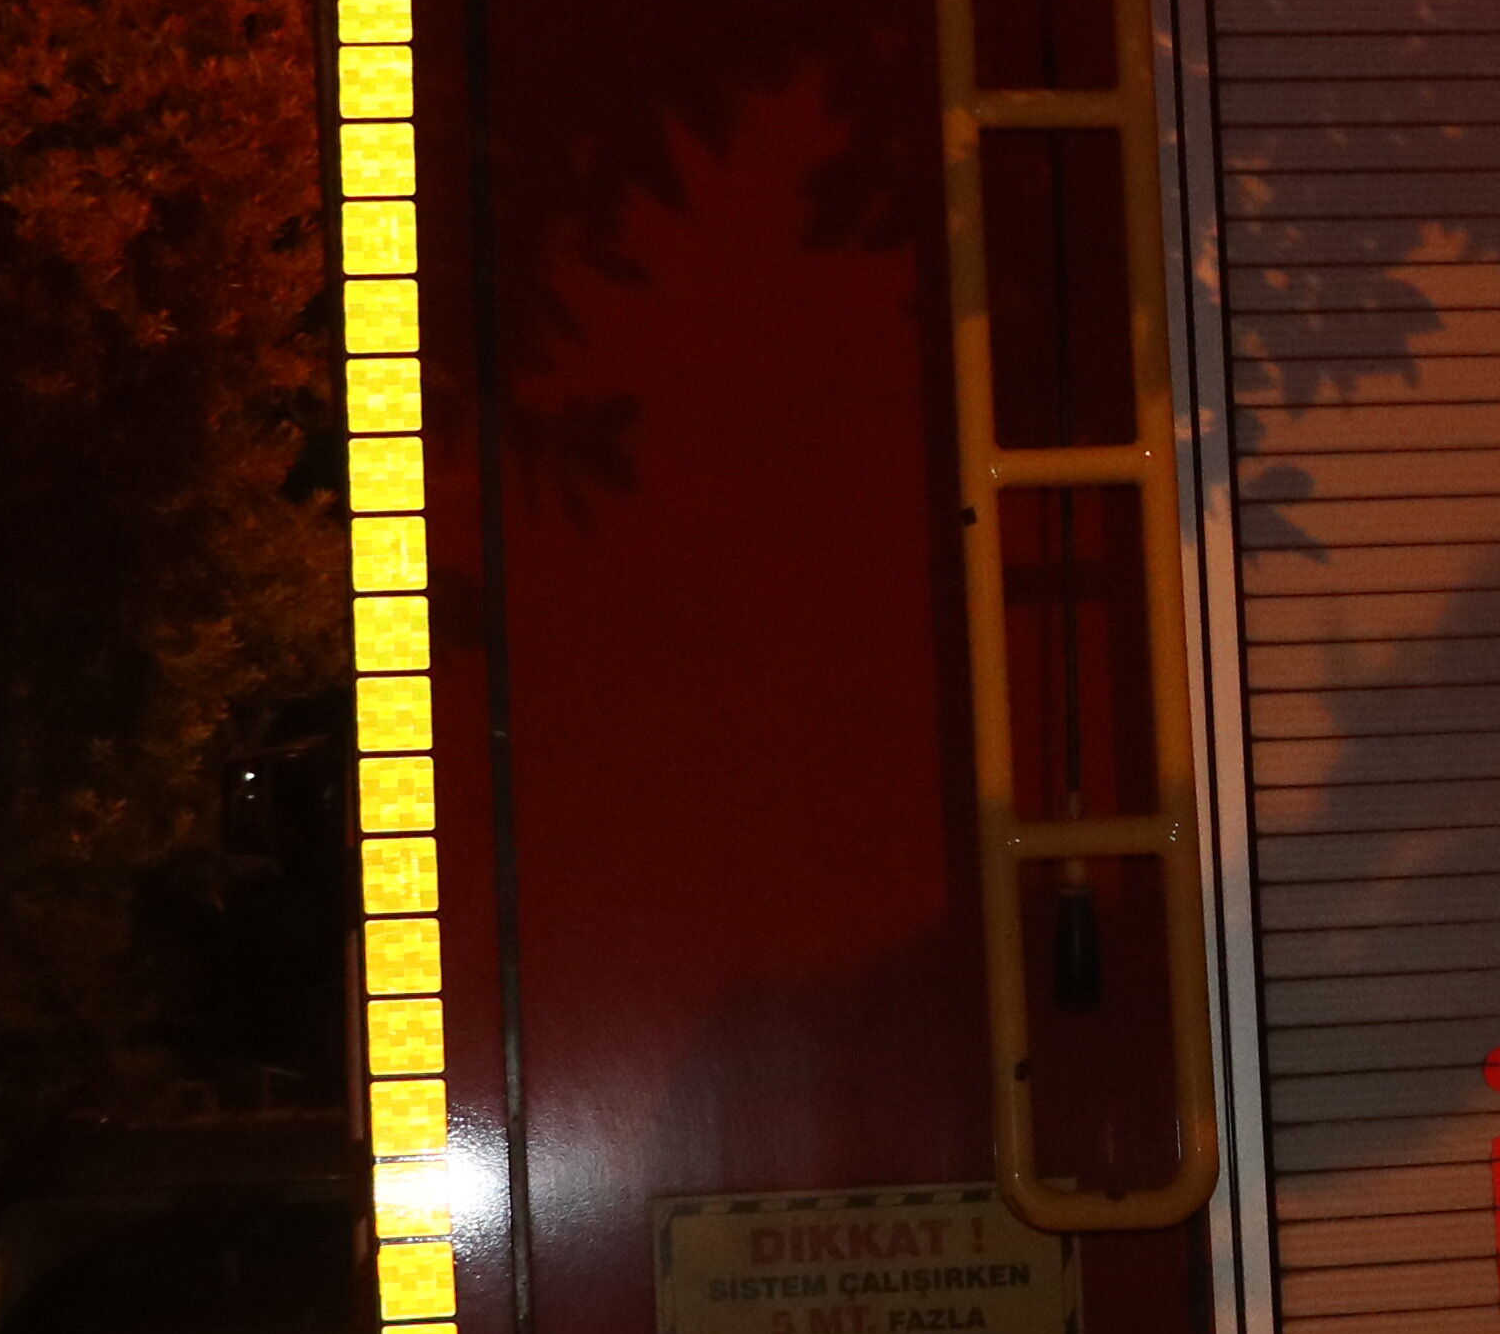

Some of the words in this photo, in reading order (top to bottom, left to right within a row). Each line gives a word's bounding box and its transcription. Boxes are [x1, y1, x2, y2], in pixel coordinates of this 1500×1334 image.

[749, 1216, 952, 1266] DİKKAT
[709, 1272, 828, 1302] SİSTEM
[839, 1264, 1031, 1303] ÇALIŞIRKEN
[889, 1307, 987, 1333] FAZLA
